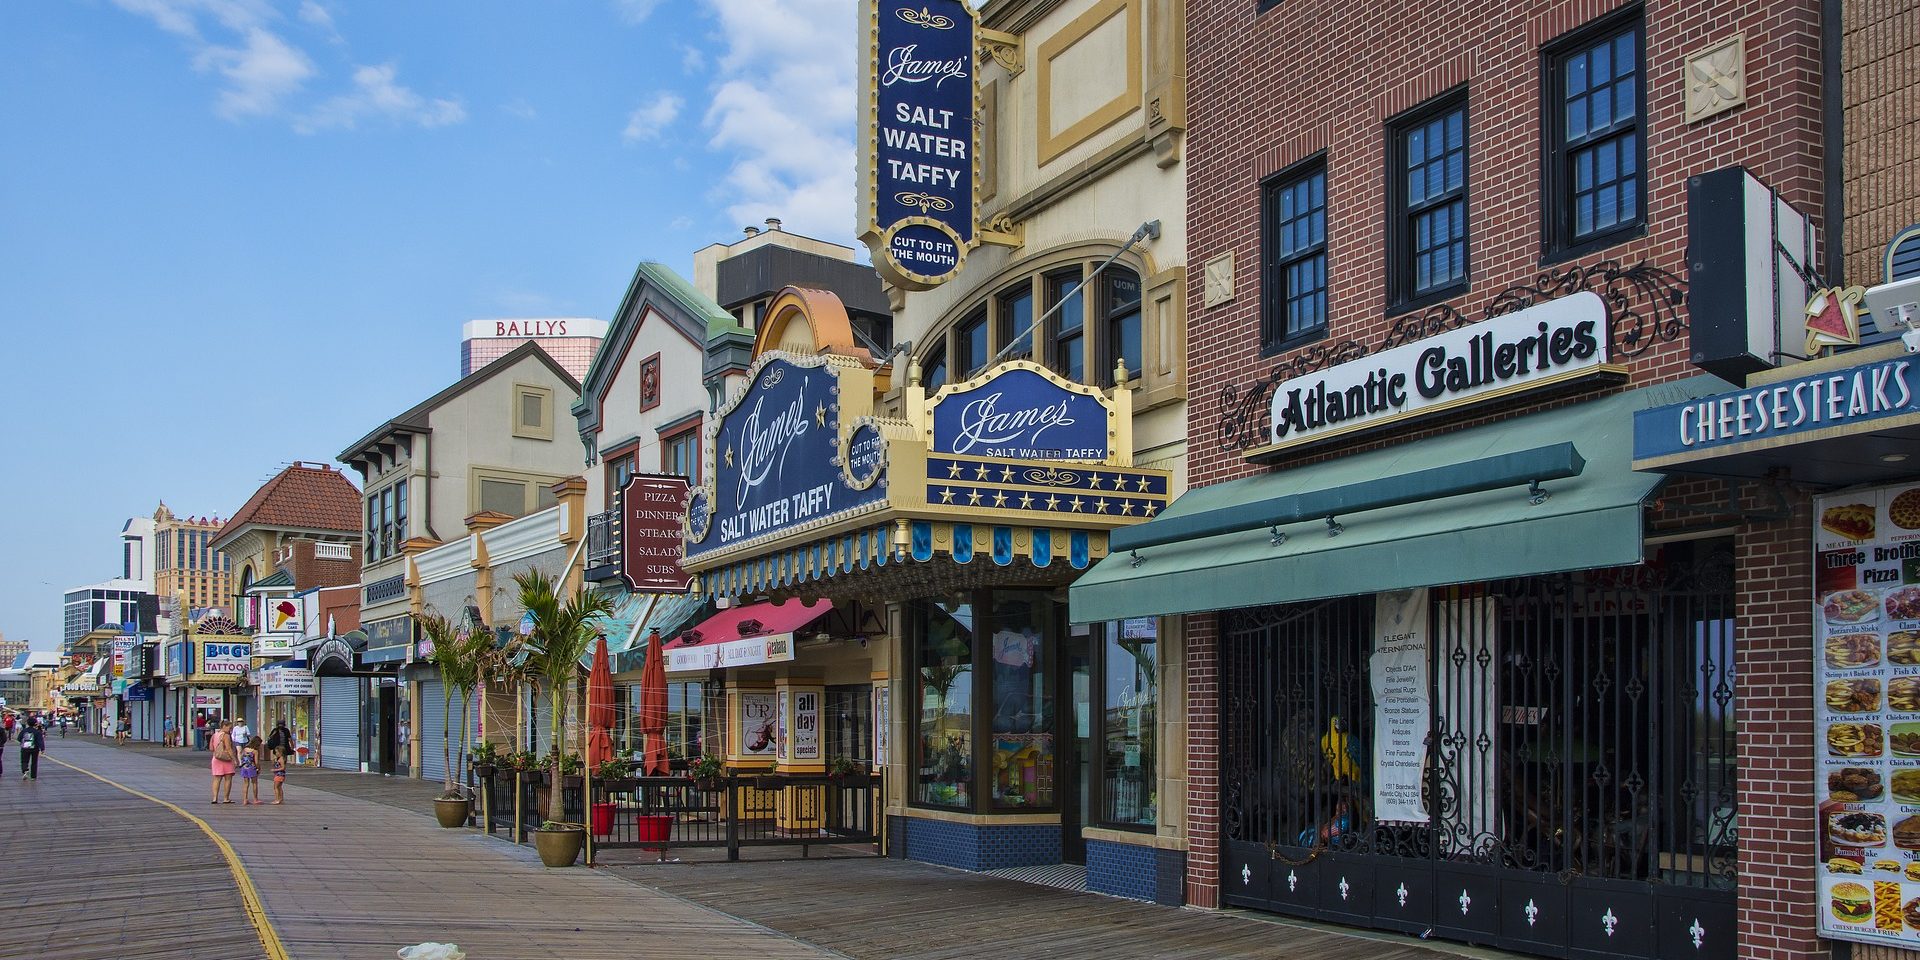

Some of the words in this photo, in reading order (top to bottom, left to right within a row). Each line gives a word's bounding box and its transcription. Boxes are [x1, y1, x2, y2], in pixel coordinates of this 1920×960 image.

[882, 44, 968, 89] James'
[896, 102, 954, 130] SALT
[884, 127, 966, 160] WATER
[887, 159, 961, 189] TAFFY
[894, 236, 917, 248] CUT
[919, 240, 934, 250] TO
[936, 242, 953, 254] FIT
[892, 248, 914, 260] THE
[916, 251, 955, 266] MOUTH
[496, 320, 567, 337] BALLYS
[1276, 367, 1407, 437] Atlantic
[1415, 320, 1597, 399] Galleries
[1680, 361, 1911, 446] CHEESESTEAKS
[953, 393, 1075, 454] James'
[736, 375, 809, 511] James'
[851, 443, 863, 456] CUT
[863, 442, 871, 452] TO
[986, 446, 1014, 459] SALT
[1020, 446, 1062, 459] WATER
[1066, 446, 1104, 459] TAFFY
[850, 457, 861, 469] THE
[862, 452, 881, 467] MOUTH
[644, 491, 677, 504] PIZZA
[721, 512, 747, 543] SALT
[749, 499, 789, 534] WATER
[792, 482, 834, 520] TAFFY
[639, 528, 682, 539] STEAK
[1826, 541, 1845, 549] MEAT
[1847, 539, 1865, 547] BALL
[639, 546, 683, 558] SALADS
[1826, 551, 1866, 568] Three
[647, 564, 675, 575] SUBS
[1863, 568, 1899, 584] Pizza
[1899, 621, 1917, 630] Clam
[1384, 632, 1417, 643] ELEGANT
[206, 644, 230, 658] BIG
[1375, 643, 1426, 654] NTERNATIONAL
[205, 663, 250, 671] TATTOOS
[1894, 667, 1910, 676] Fish
[1911, 666, 1919, 675] &
[64, 683, 79, 691] FOOD
[1403, 686, 1417, 695] Rugs
[799, 694, 814, 711] all
[797, 713, 816, 732] day
[1840, 714, 1864, 722] Chicken
[797, 745, 817, 755] specials
[1889, 759, 1914, 767] Chicken
[1860, 849, 1878, 858] Cake
[1876, 928, 1900, 937] FRIES
